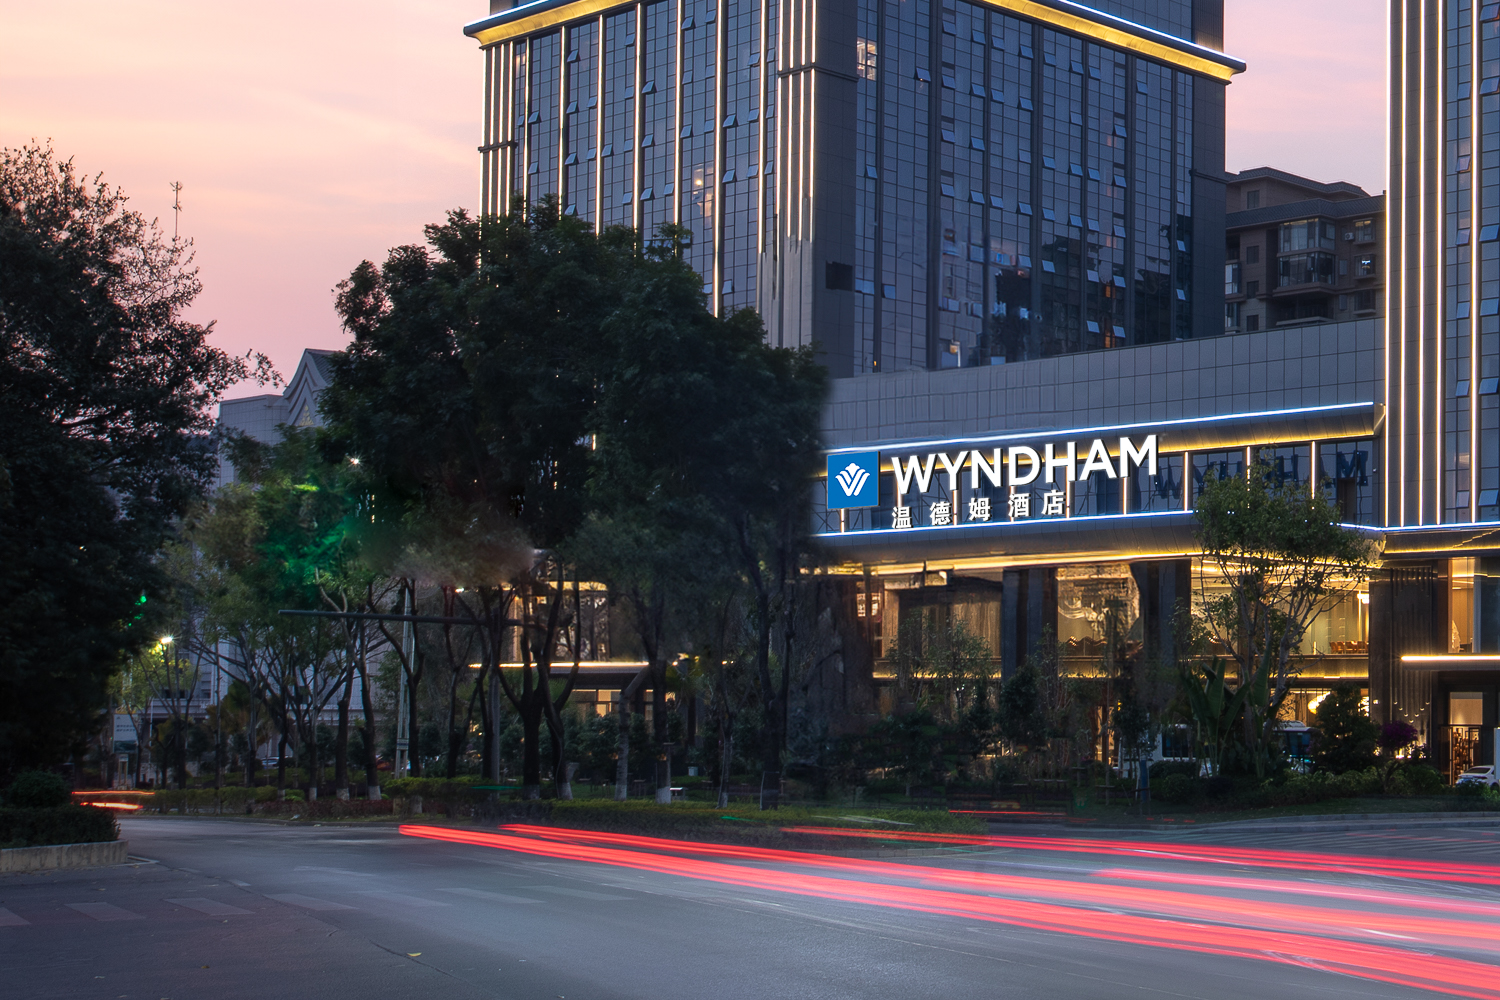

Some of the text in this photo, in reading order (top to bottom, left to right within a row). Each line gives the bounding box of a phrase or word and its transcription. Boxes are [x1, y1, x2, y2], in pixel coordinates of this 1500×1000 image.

[891, 434, 1159, 495] WYNDHAM
[891, 489, 1067, 529] 温德姆酒店
